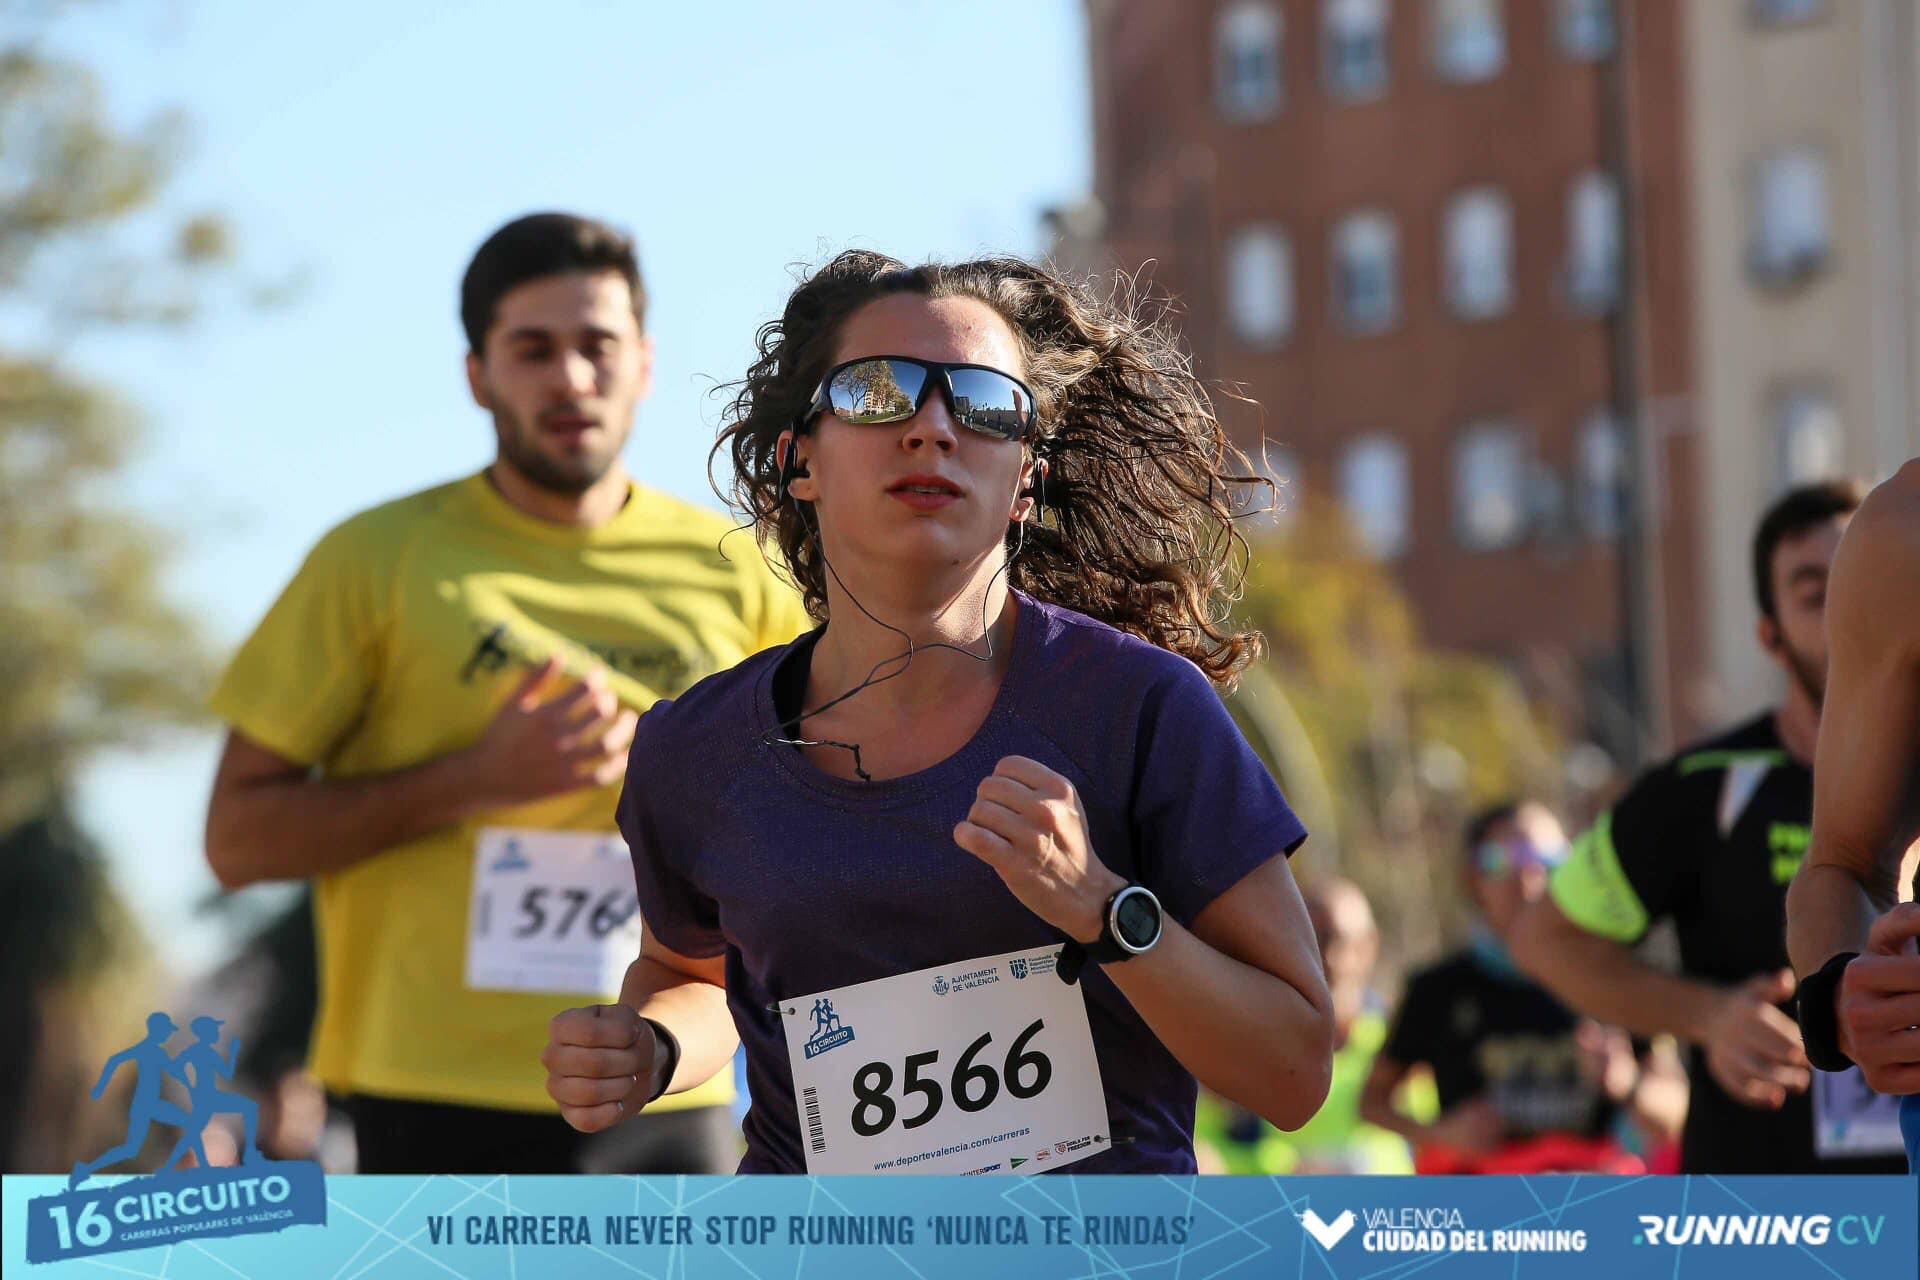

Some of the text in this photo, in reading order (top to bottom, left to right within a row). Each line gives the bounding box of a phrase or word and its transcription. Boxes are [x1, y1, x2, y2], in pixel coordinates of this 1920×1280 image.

[513, 886, 641, 941] 576
[951, 967, 998, 984] AJUNTAMENT
[952, 985, 963, 993] DE
[807, 1042, 820, 1056] 16
[818, 1030, 848, 1047] CIRCUITO
[850, 1018, 1053, 1137] 8566
[874, 1127, 1030, 1170] www.deportevalencia.com/carreras
